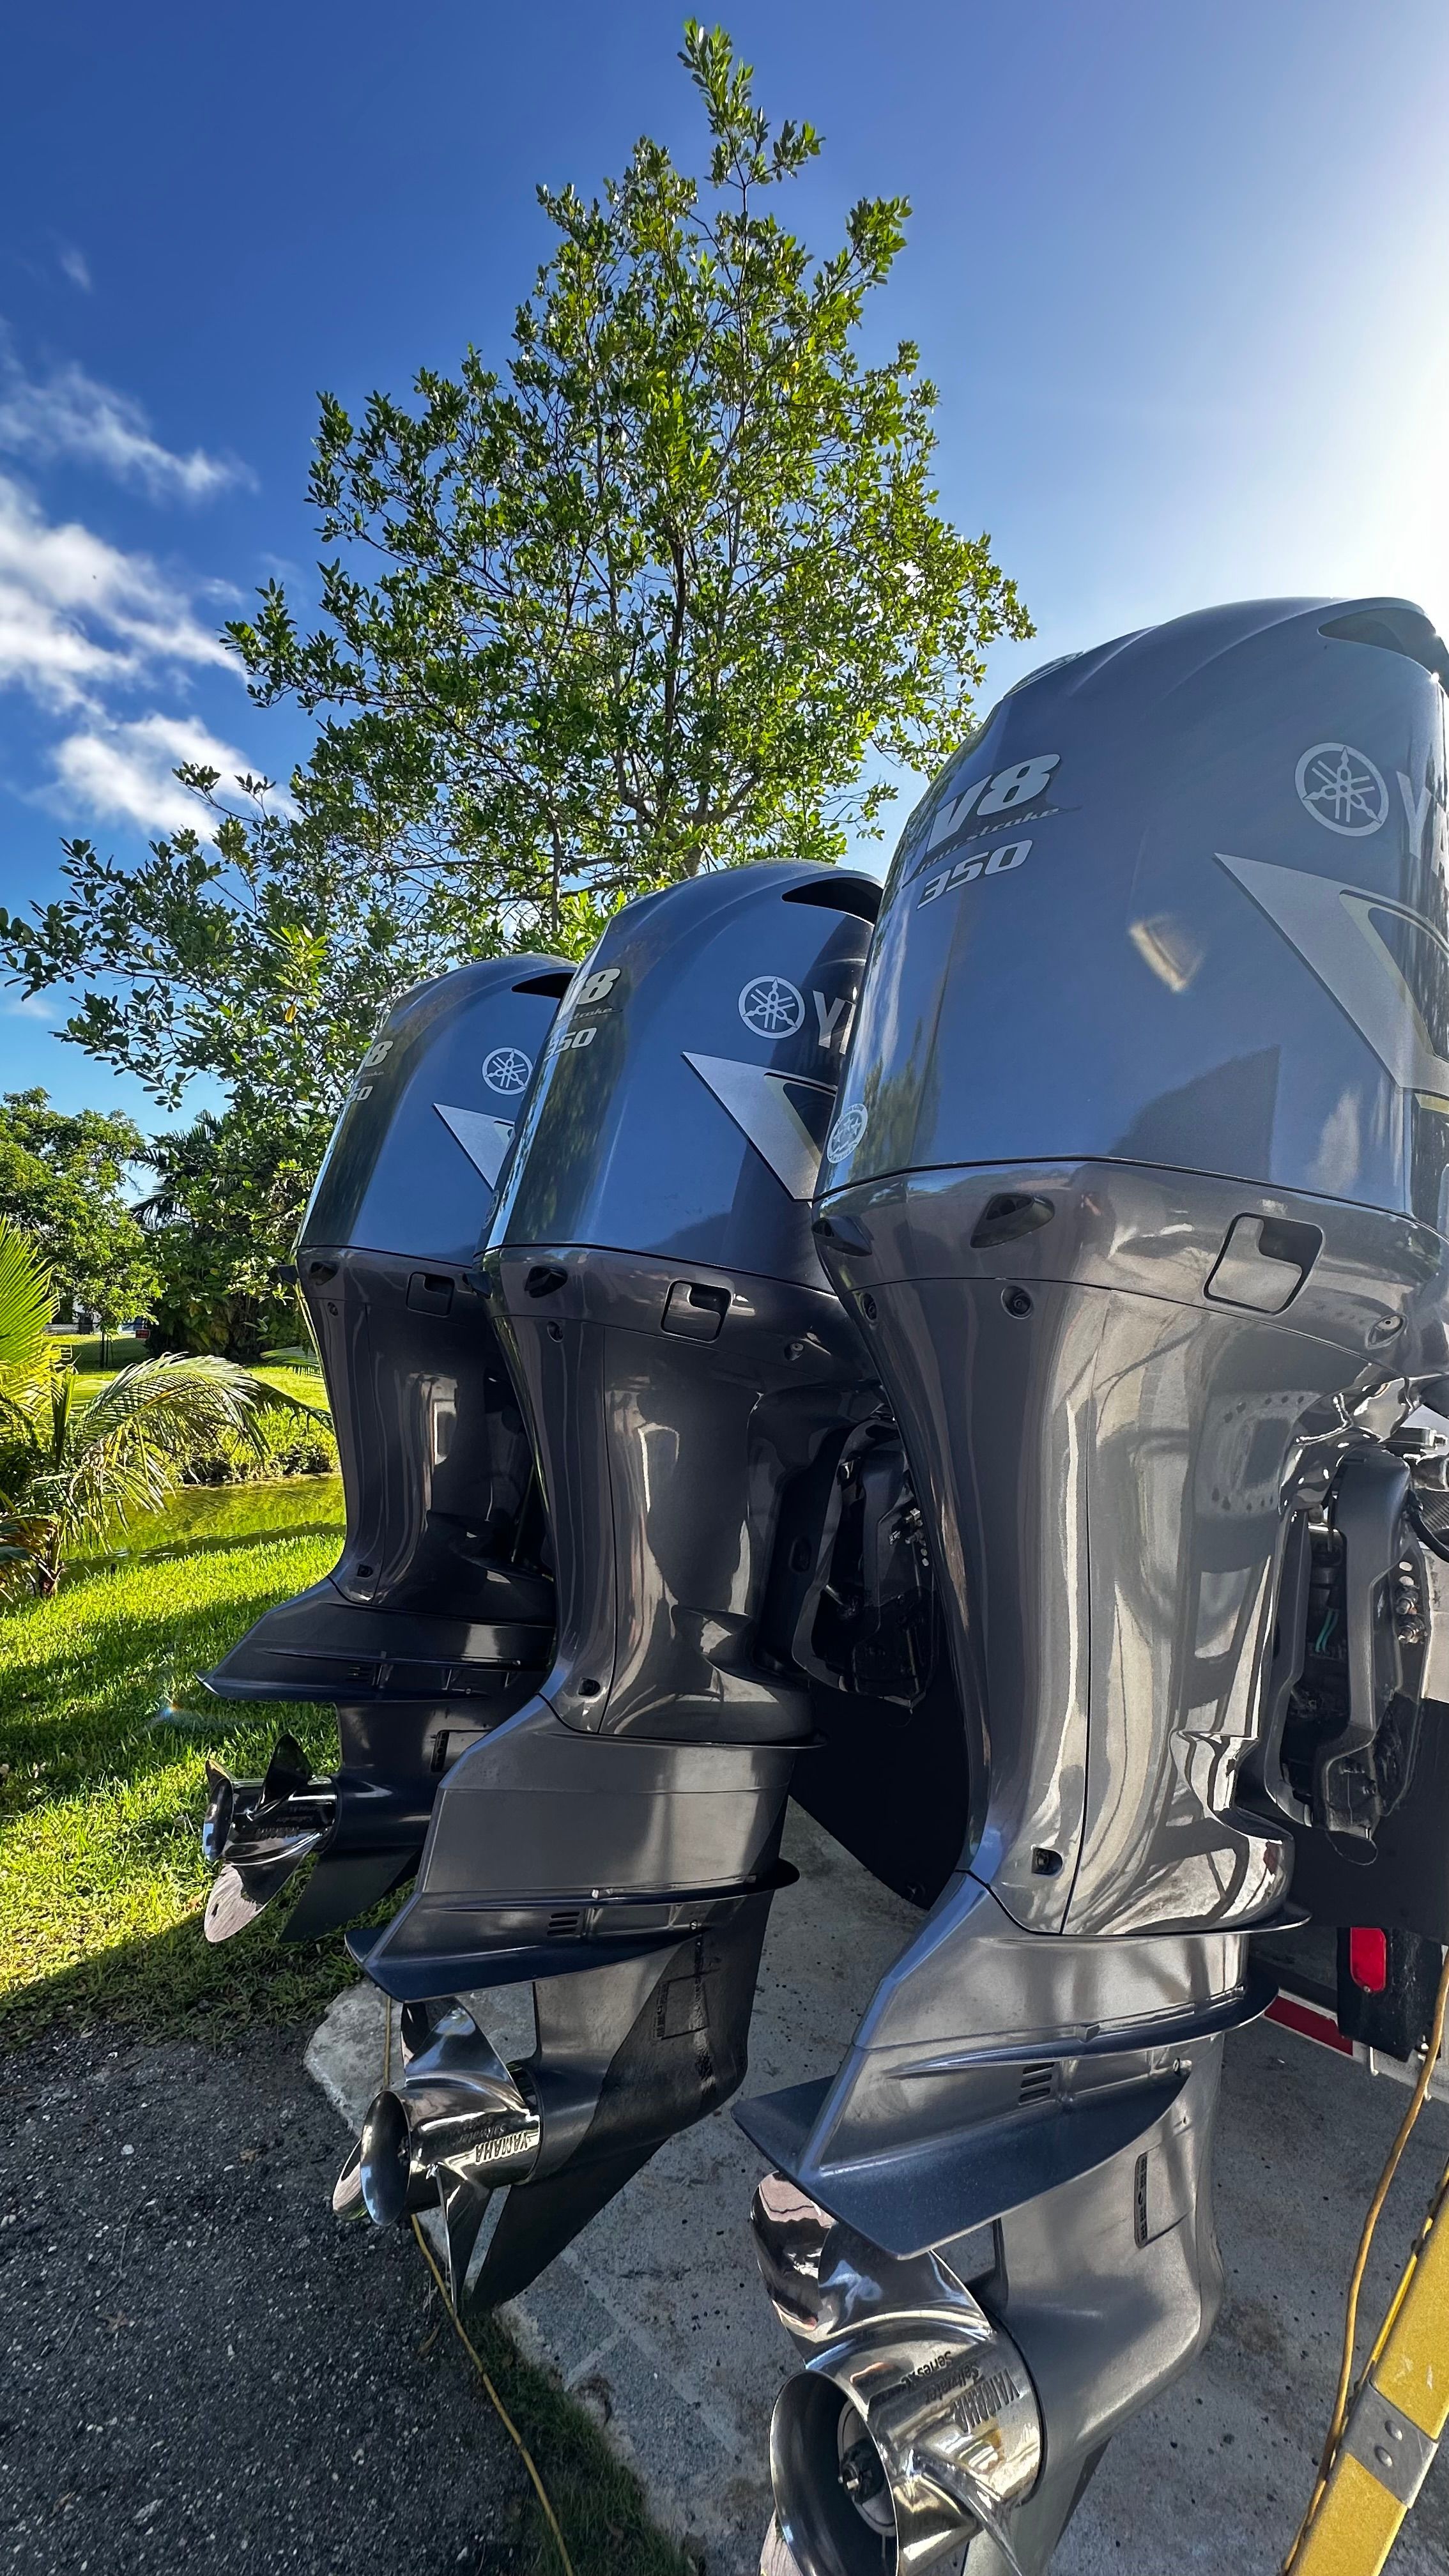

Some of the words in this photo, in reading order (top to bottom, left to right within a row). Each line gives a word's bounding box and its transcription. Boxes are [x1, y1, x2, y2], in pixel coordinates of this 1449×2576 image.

[926, 754, 1061, 852] V8
[917, 839, 1033, 910] 350
[544, 1027, 597, 1062] 350
[348, 1085, 373, 1103] 50
[476, 2131, 528, 2163] YAMAHA
[917, 2350, 952, 2377] Series
[925, 2359, 985, 2404] Saltwater
[954, 2368, 1020, 2434] YAMAHA
